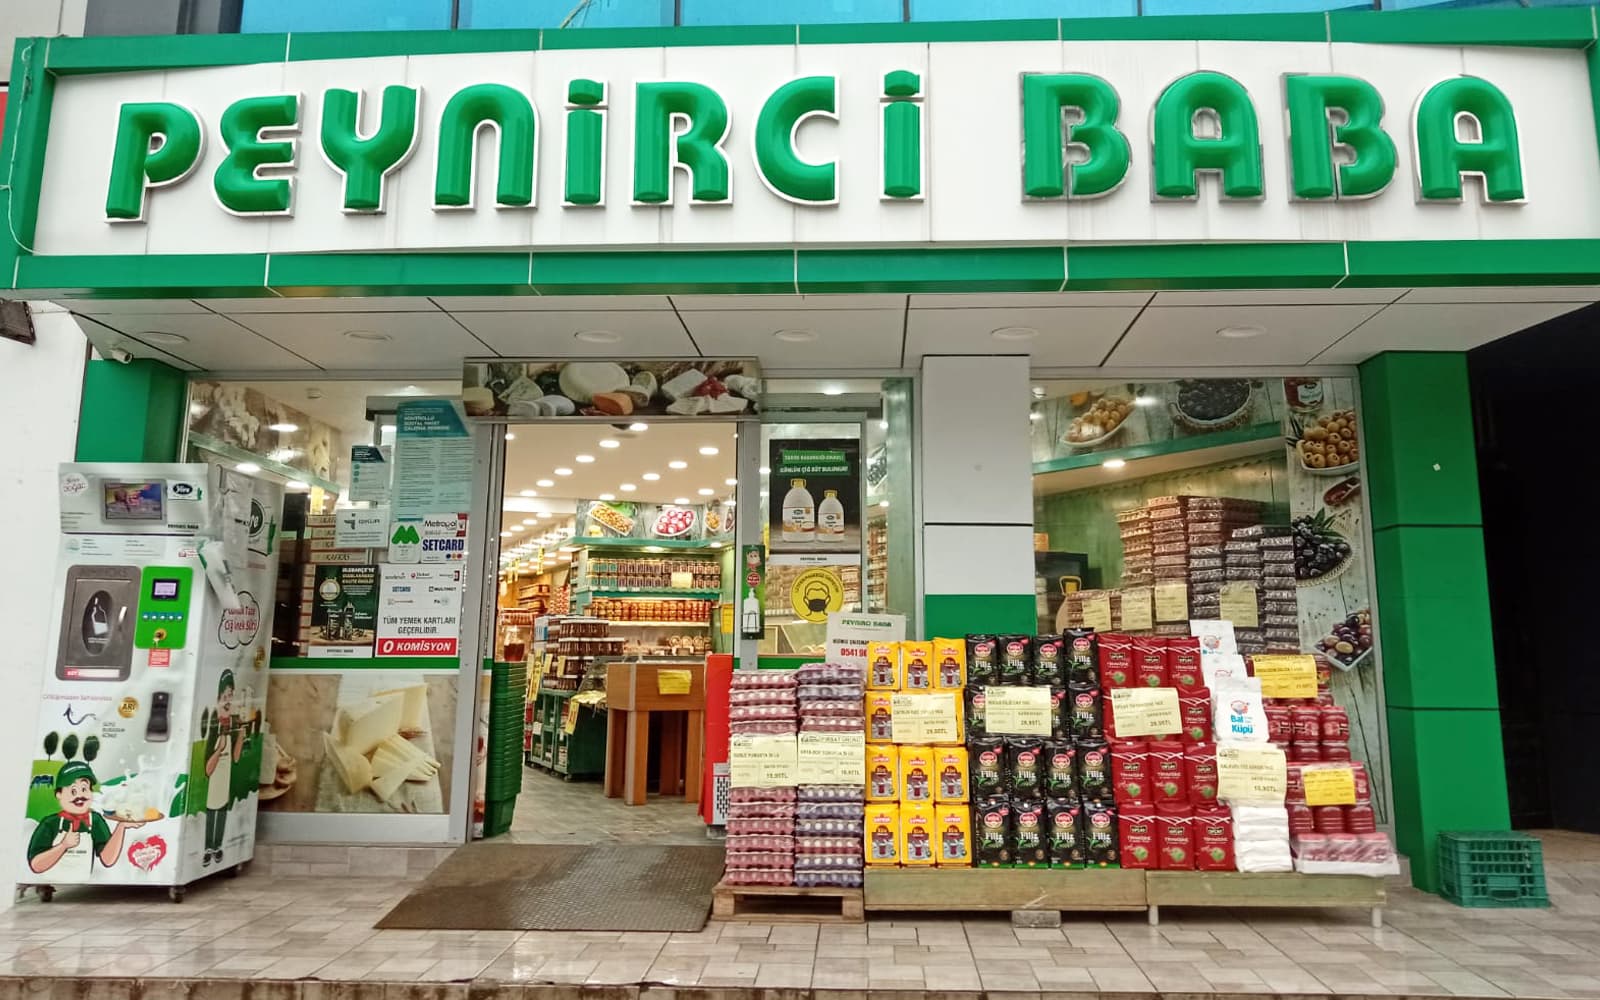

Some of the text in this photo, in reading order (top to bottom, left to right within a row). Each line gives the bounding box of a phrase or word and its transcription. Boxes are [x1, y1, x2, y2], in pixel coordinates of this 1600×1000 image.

[106, 70, 1526, 222] PEYNİRCİ BABA
[422, 539, 464, 551] SETCARD
[383, 616, 456, 625] TÜM YEMEK KARTLARI
[397, 640, 451, 651] KOMİSYON
[1230, 714, 1244, 722] Bal
[1231, 723, 1253, 734] Küpü
